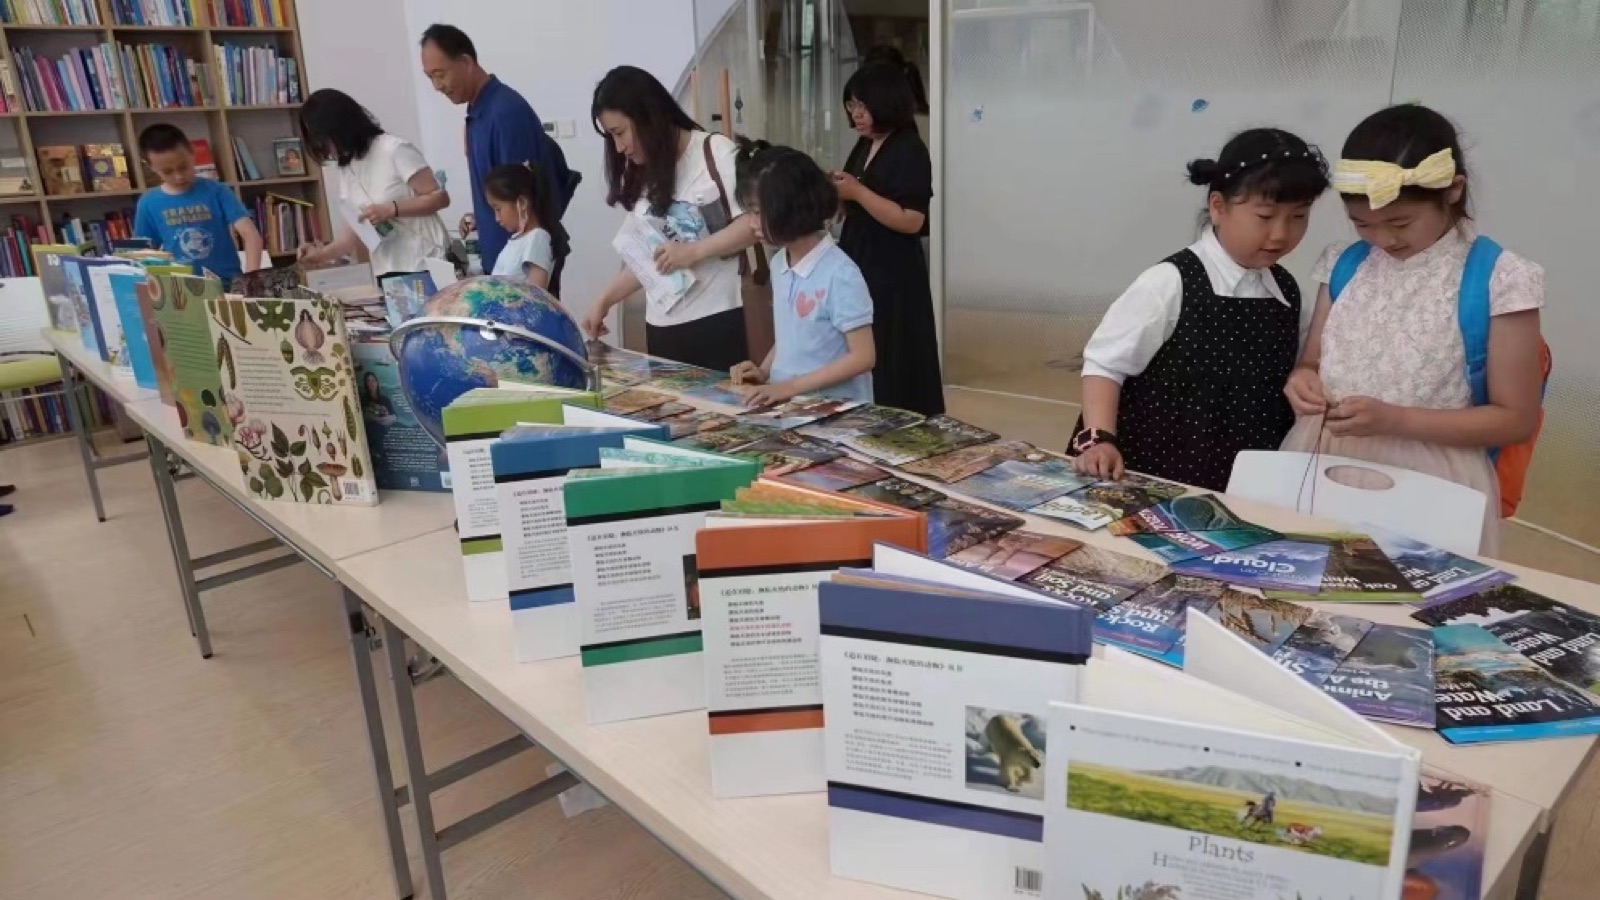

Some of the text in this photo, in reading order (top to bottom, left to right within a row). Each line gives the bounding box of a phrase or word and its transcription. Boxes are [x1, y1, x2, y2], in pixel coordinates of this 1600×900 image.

[1435, 689, 1508, 704] Wate
[1440, 705, 1492, 720] and
[1492, 698, 1566, 719] Land
[1187, 835, 1255, 863] Plants
